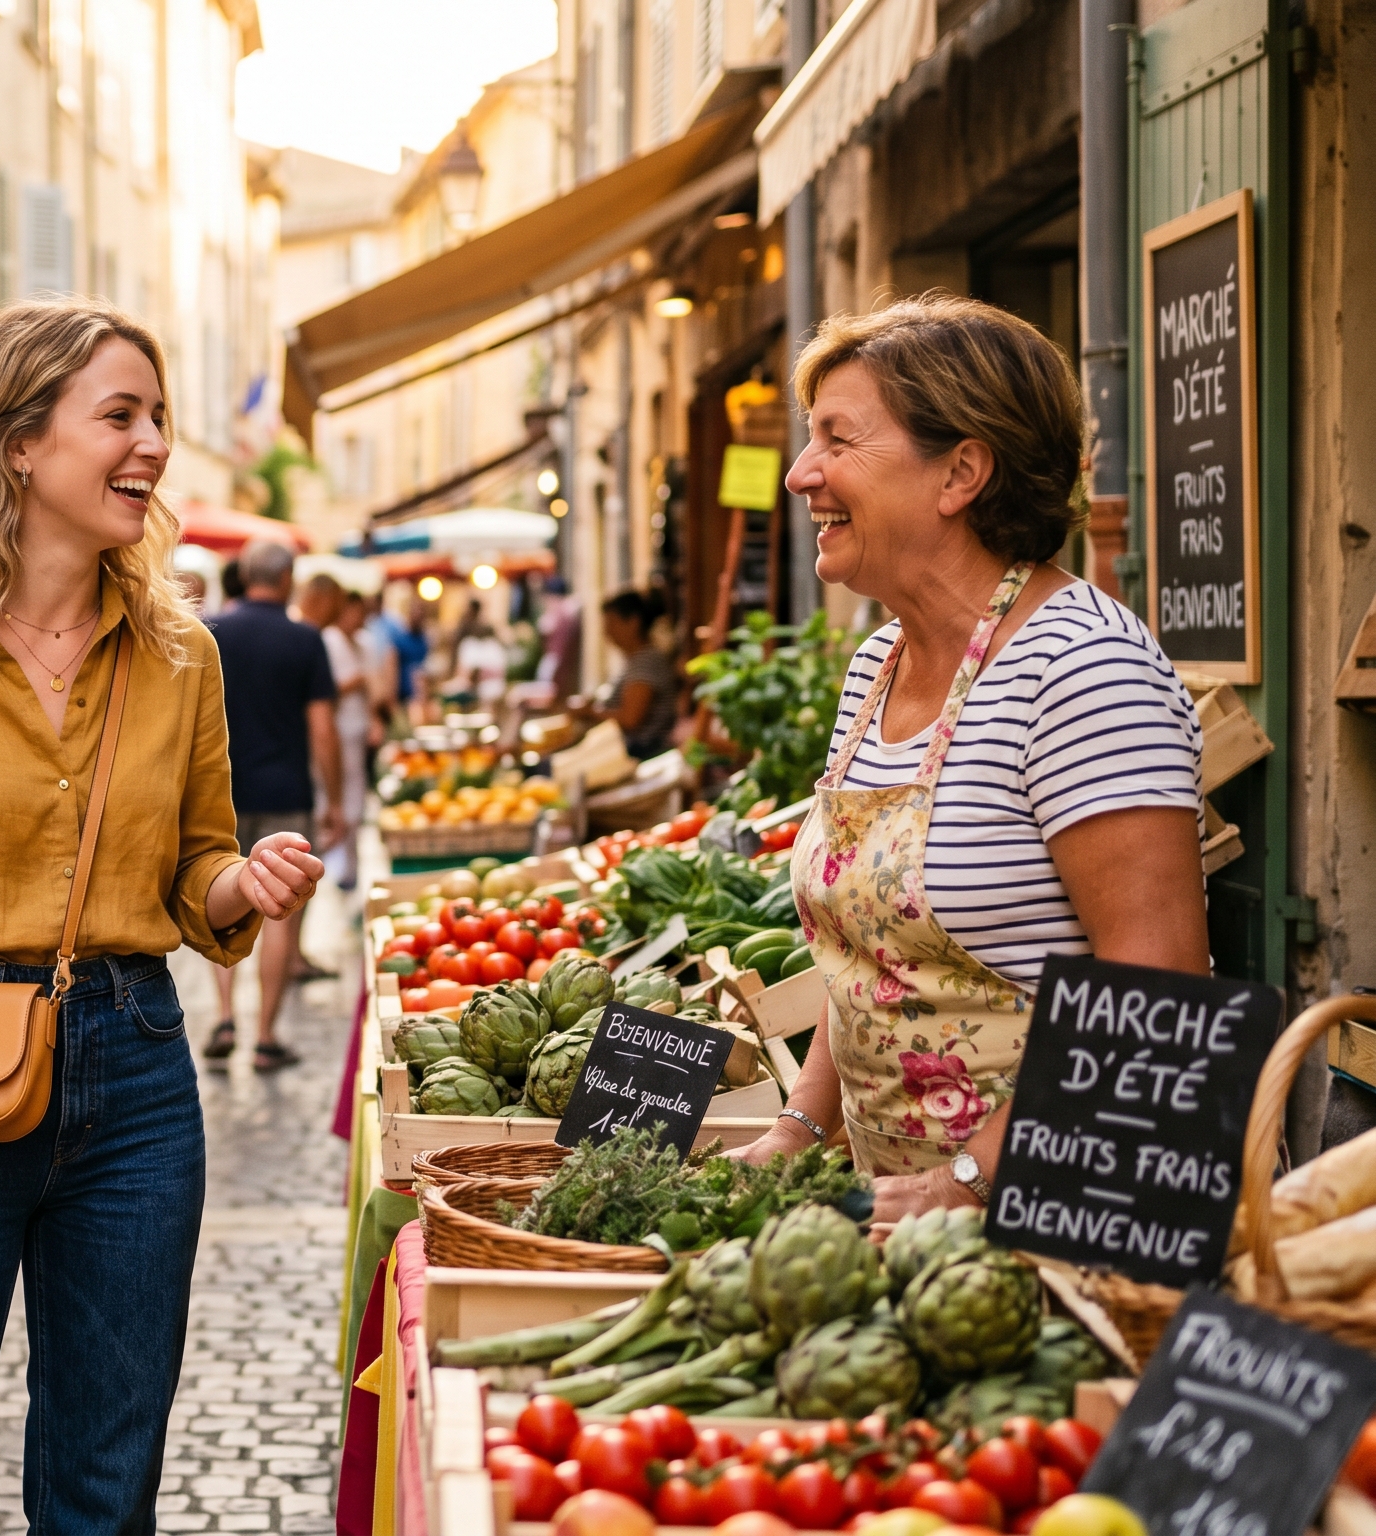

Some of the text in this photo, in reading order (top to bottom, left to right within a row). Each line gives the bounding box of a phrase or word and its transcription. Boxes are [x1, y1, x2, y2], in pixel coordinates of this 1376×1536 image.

[1160, 262, 1236, 360] MARCHÉ
[1173, 348, 1227, 425] D'ÉTÉ
[1049, 977, 1251, 1052] MARCHÉ
[620, 1076, 636, 1100] de
[1059, 1048, 1210, 1111] D'ÉTÉ
